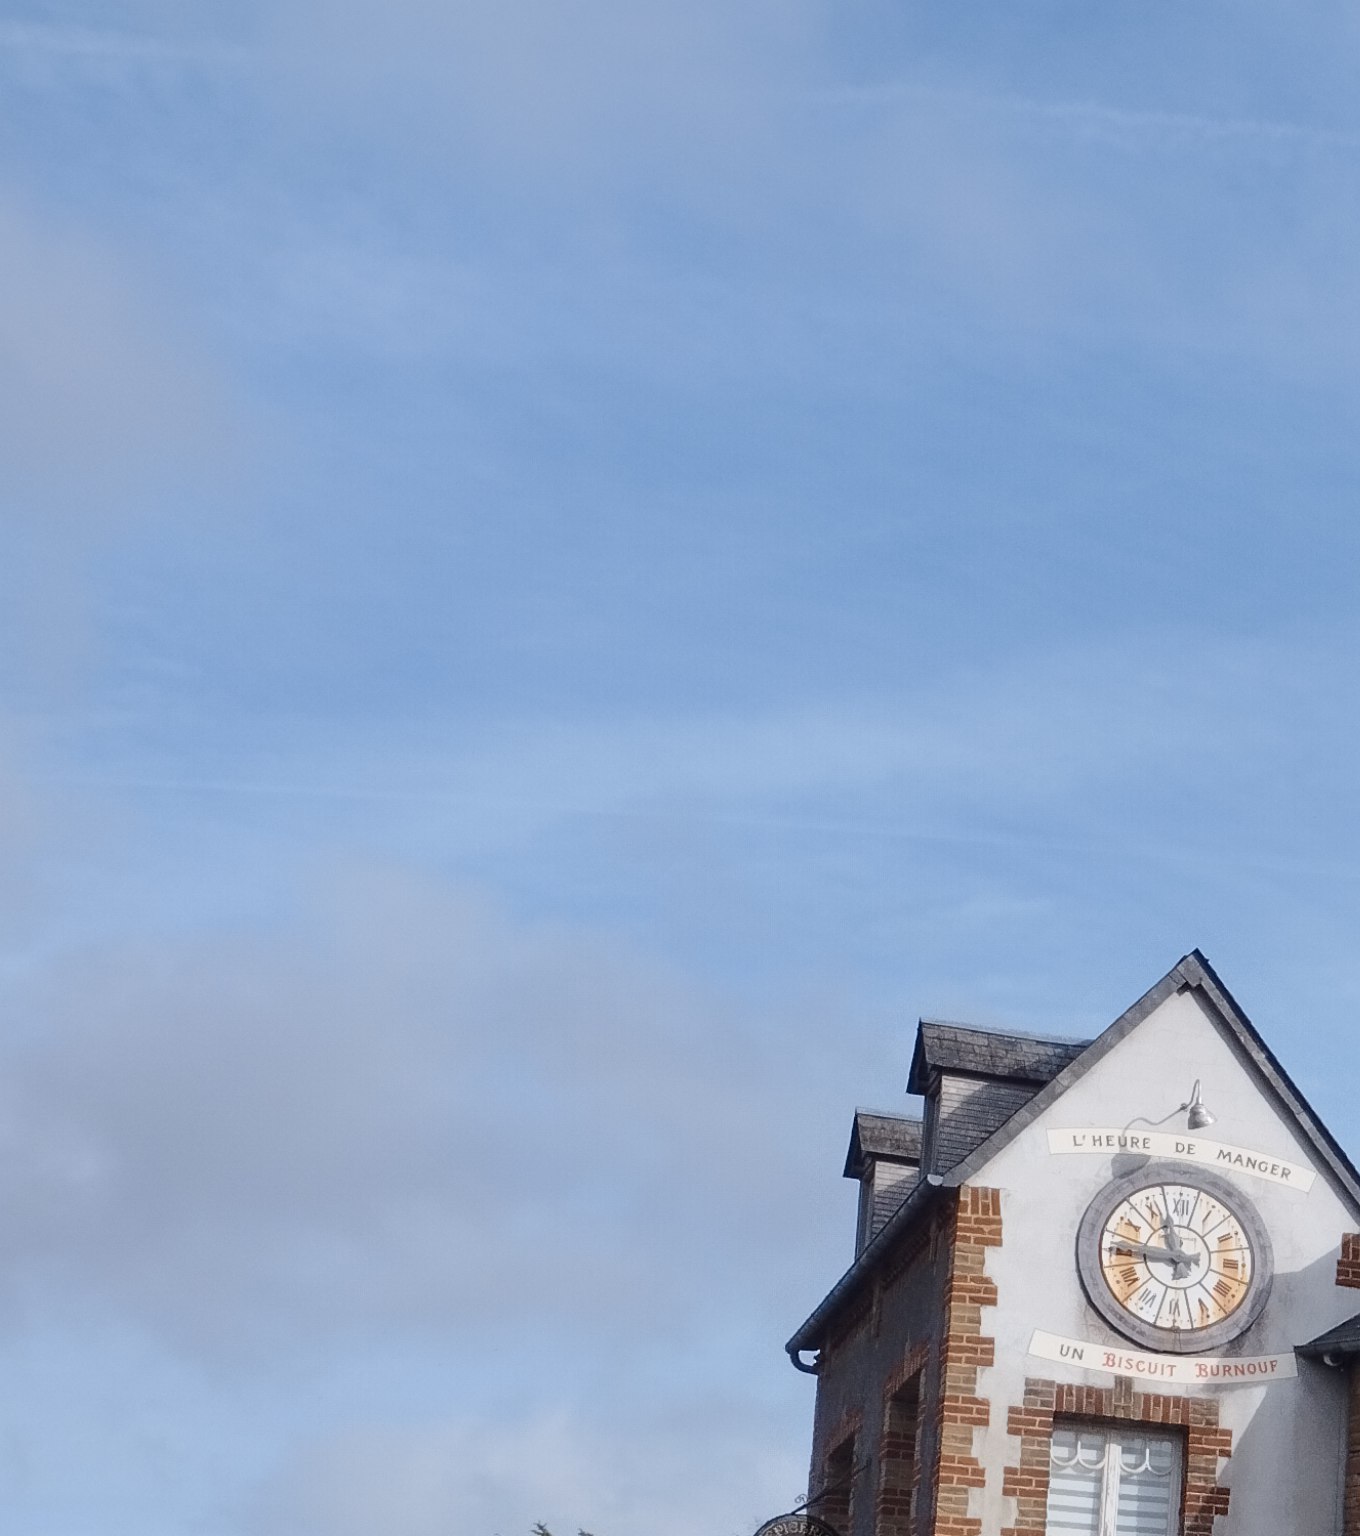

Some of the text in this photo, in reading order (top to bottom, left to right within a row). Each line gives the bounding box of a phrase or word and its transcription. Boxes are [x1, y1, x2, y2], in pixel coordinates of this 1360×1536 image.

[1073, 1135, 1292, 1181] L'HEURE DE MANGER
[1060, 1345, 1279, 1378] UN BISCUIT BURNOUF
